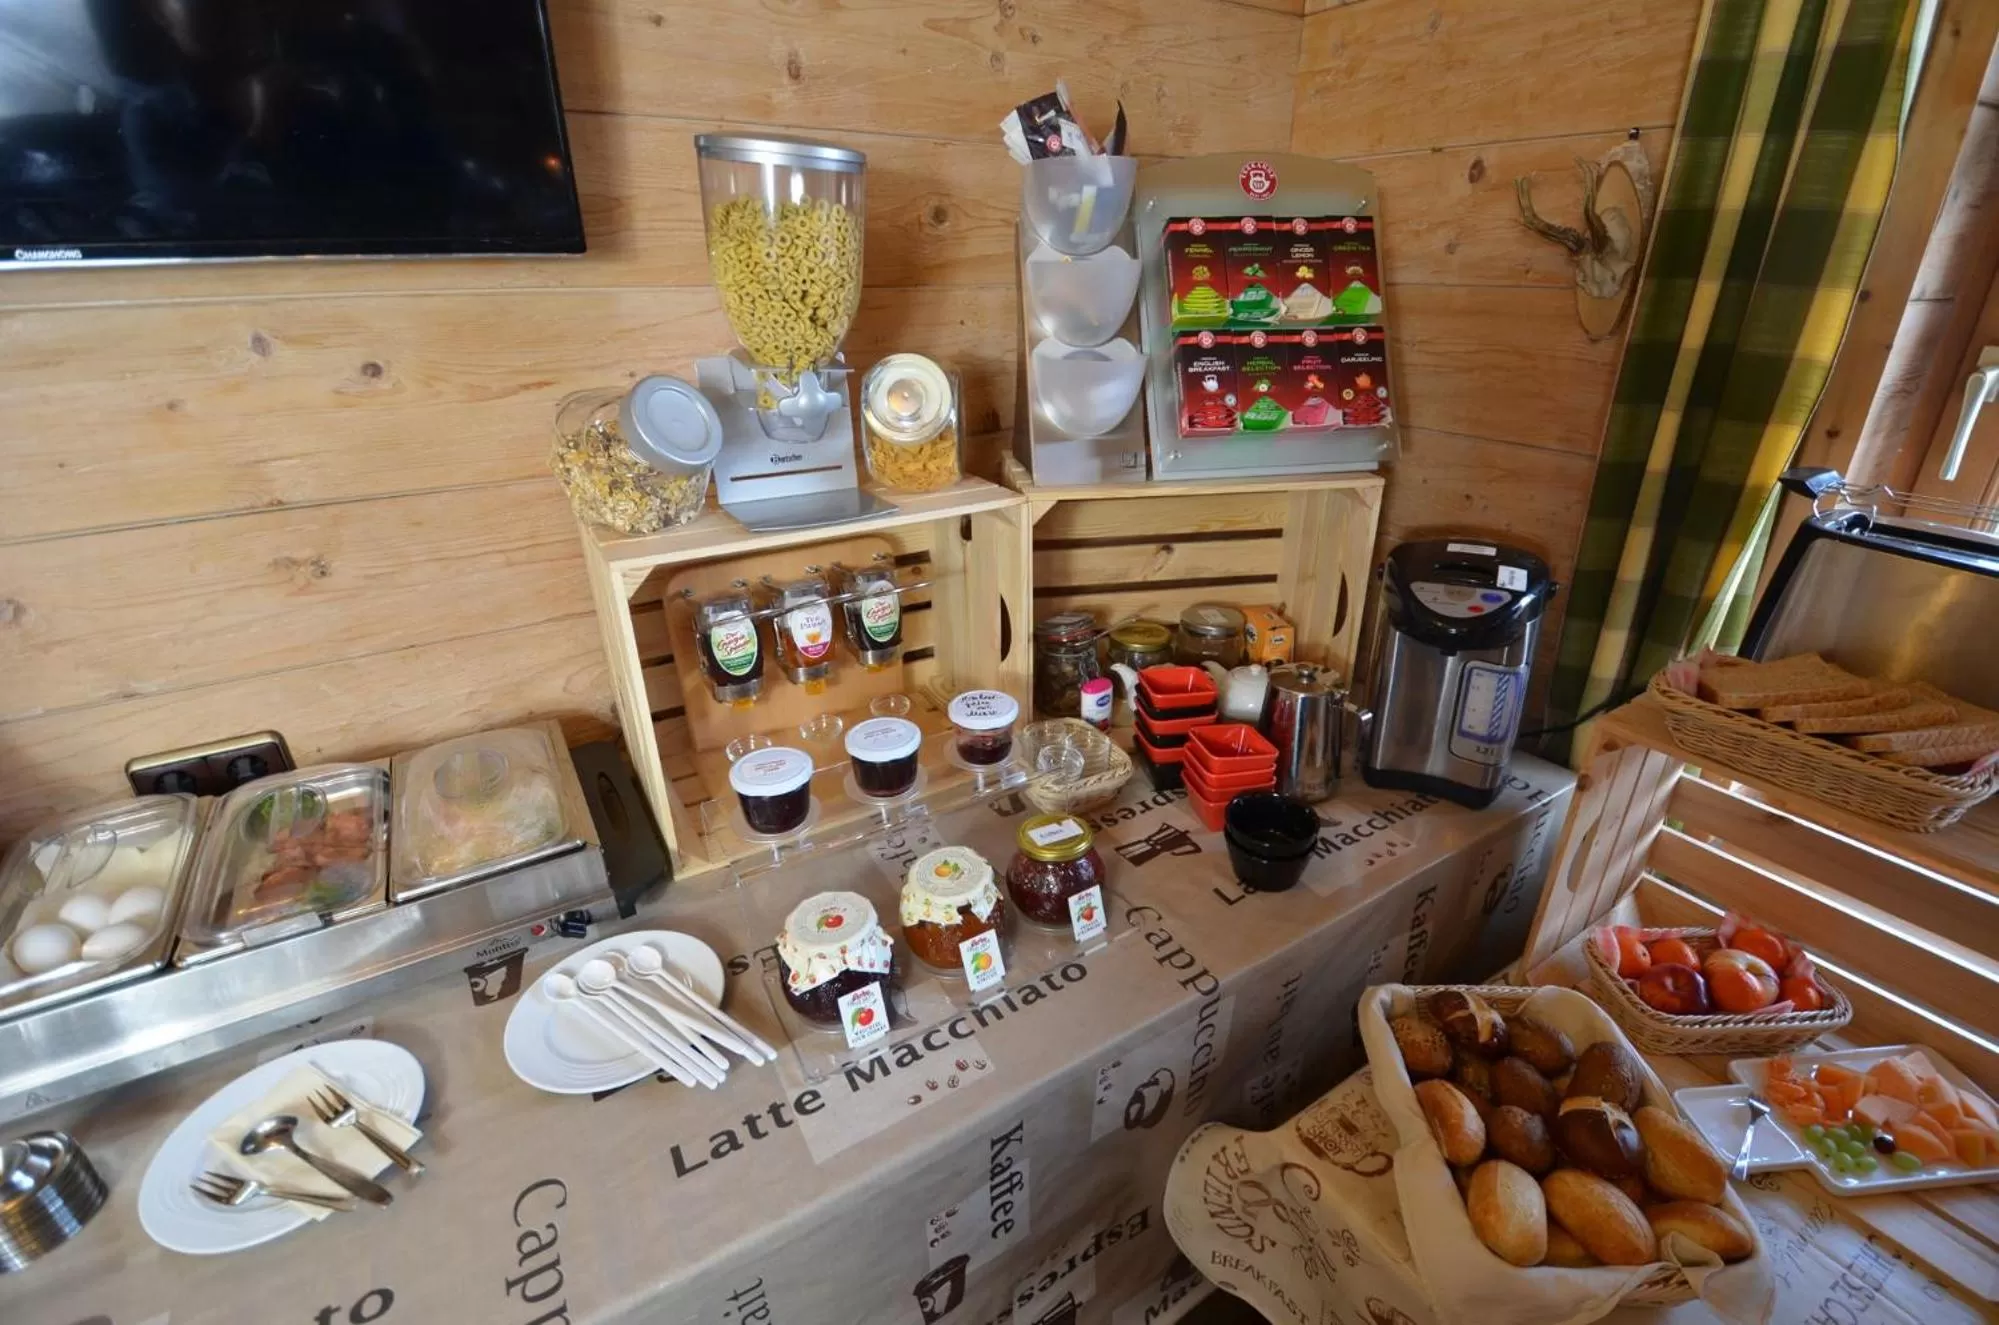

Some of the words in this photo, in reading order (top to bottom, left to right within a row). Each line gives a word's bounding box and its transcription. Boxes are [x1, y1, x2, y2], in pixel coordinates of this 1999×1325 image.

[668, 1088, 827, 1180] Latte
[843, 961, 1089, 1082] Macchiato
[989, 1120, 1025, 1240] Kaffee
[1203, 1135, 1278, 1255] FRIENDS
